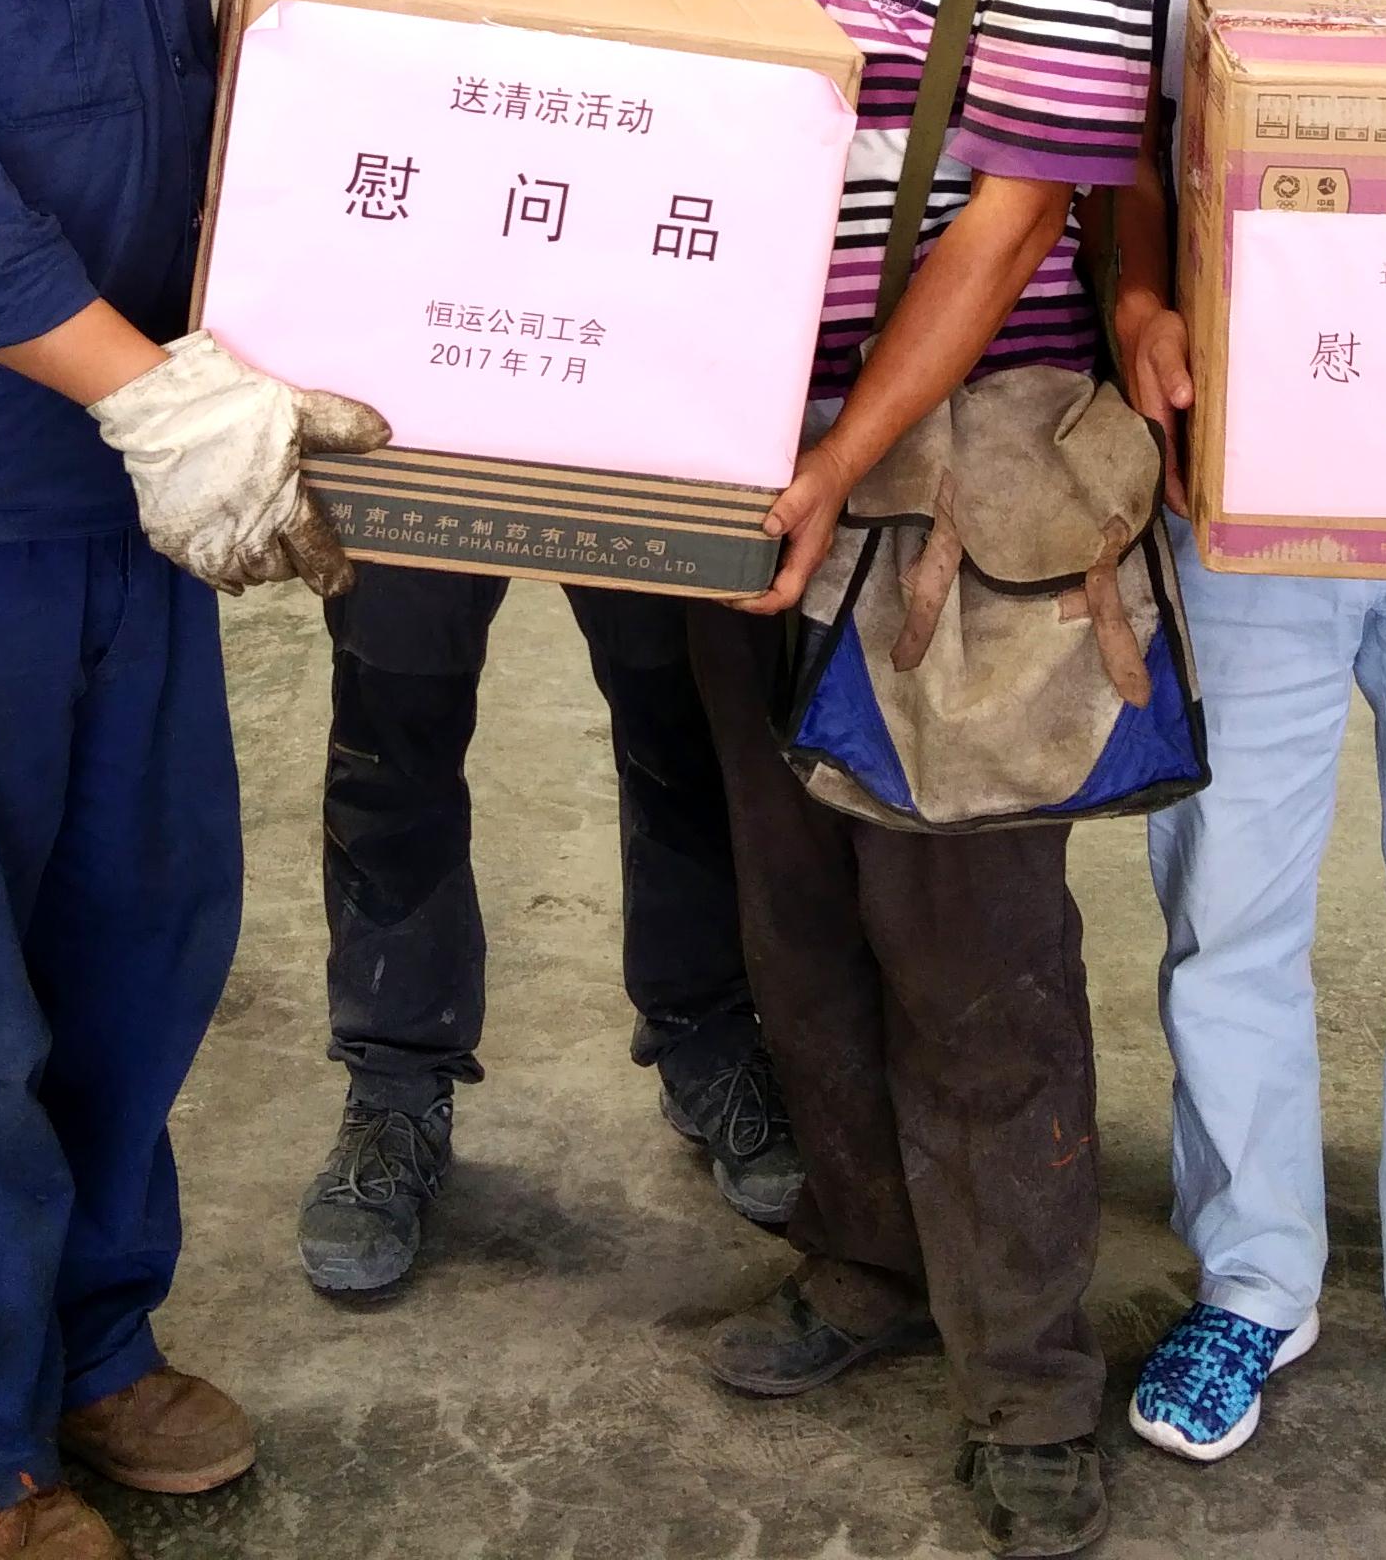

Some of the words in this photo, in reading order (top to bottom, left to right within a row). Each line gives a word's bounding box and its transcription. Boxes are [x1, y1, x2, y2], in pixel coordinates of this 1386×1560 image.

[450, 75, 654, 136] 送清凉活动
[425, 298, 607, 347] 恒运公司工会
[330, 502, 668, 557] 湖南中和制药有限公司
[363, 524, 449, 547] ZHONGHE
[458, 535, 618, 566] PHARMACEUTICAL
